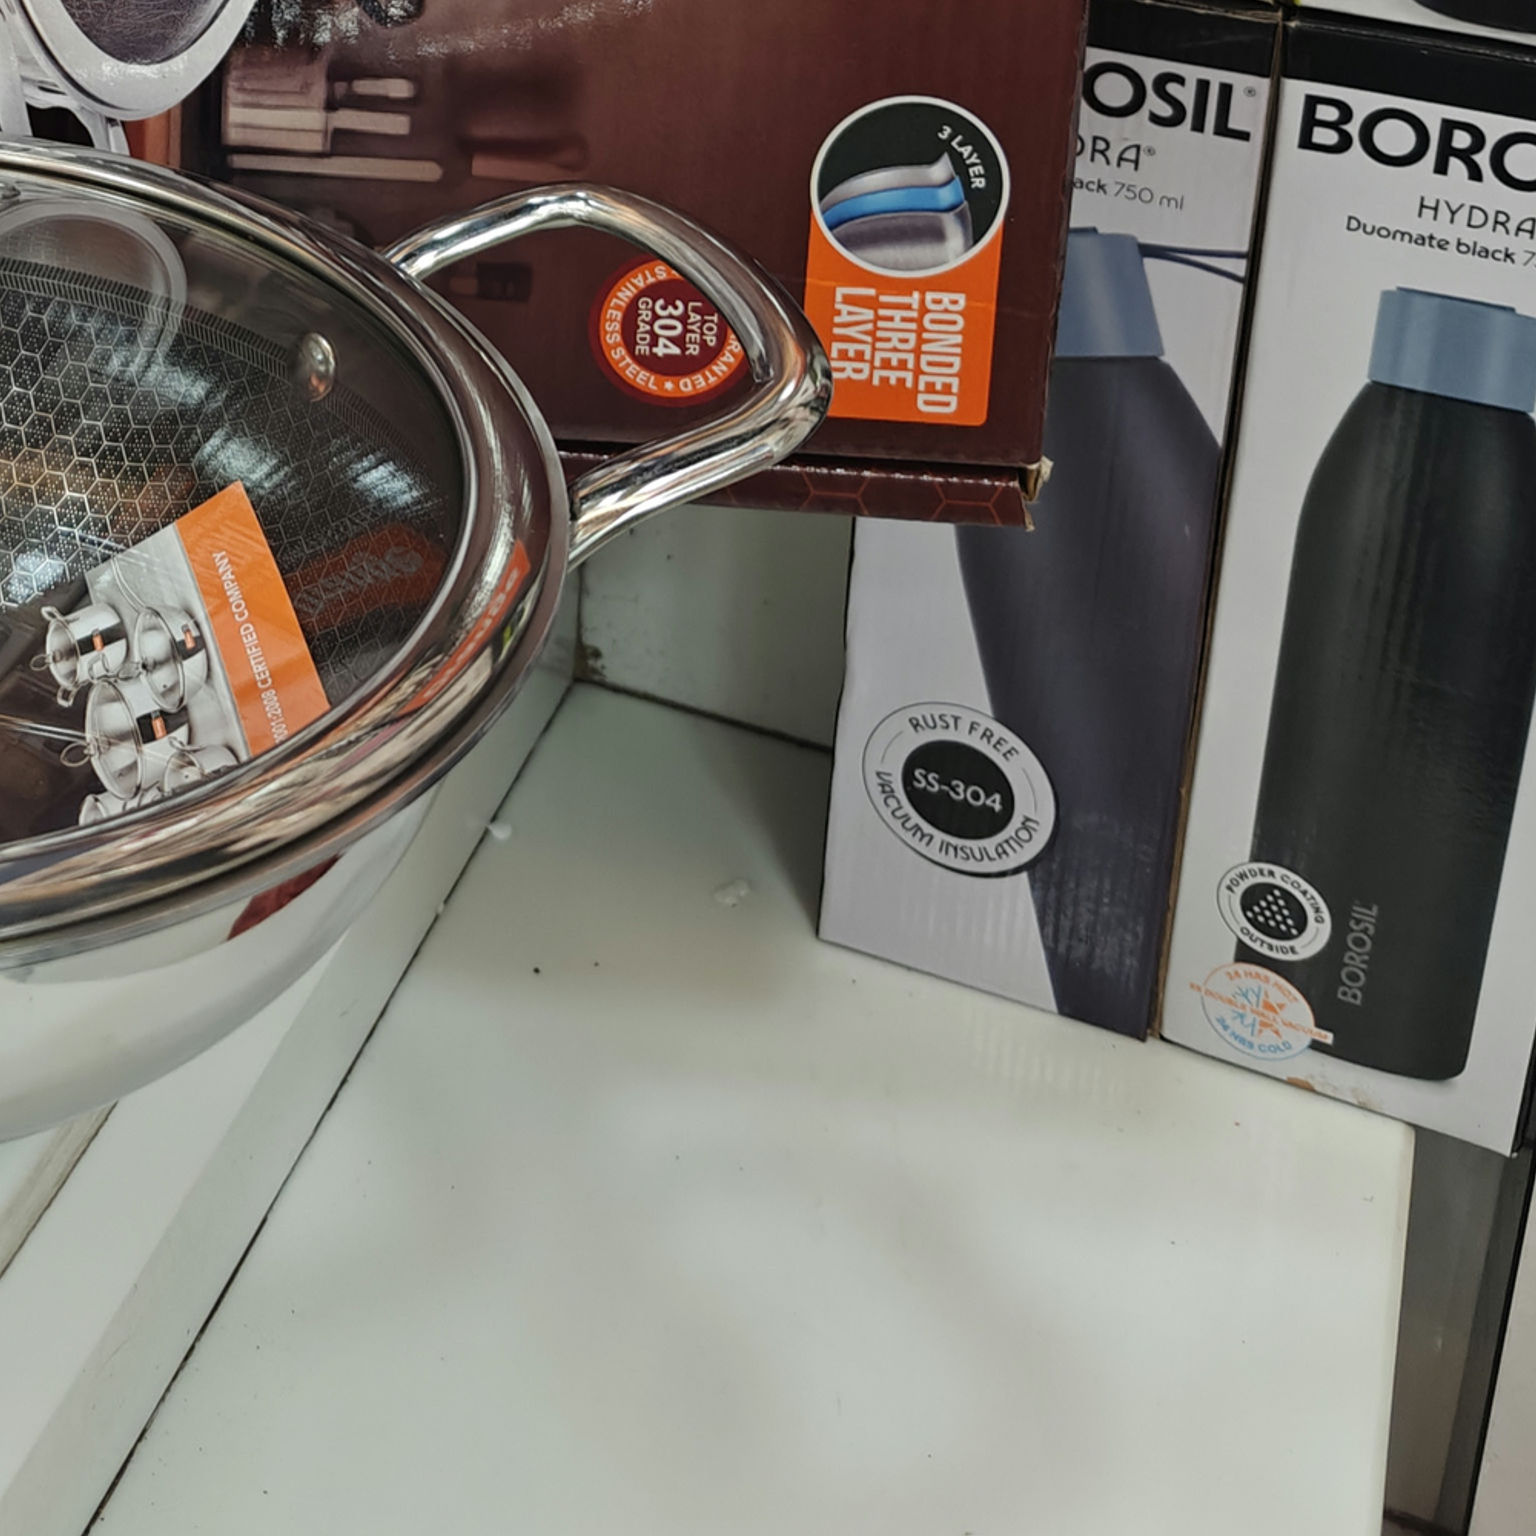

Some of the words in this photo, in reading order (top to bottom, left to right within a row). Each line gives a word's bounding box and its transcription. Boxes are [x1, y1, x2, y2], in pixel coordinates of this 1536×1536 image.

[1082, 60, 1252, 143] OSIL
[937, 124, 953, 140] 3
[950, 134, 986, 189] LAYER
[1072, 177, 1108, 196] ack
[1113, 180, 1155, 205] 750
[1159, 194, 1185, 212] ml
[1417, 194, 1536, 241] HYDRA
[1345, 215, 1451, 252] Duomate
[1455, 237, 1516, 265] black
[1522, 249, 1536, 267] 7
[604, 265, 667, 345] STAINLESS
[634, 296, 653, 357] GRADE
[651, 297, 686, 358] 304
[684, 301, 703, 356] LAYER
[701, 312, 719, 348] TOP
[830, 285, 877, 381] LAYER
[610, 346, 659, 391] STEEL
[678, 332, 742, 393] RANTED
[872, 290, 921, 389] THREE
[916, 290, 966, 414] BONDED
[211, 549, 249, 622] COMPANY
[239, 622, 275, 689] CERTIFIED
[907, 713, 963, 734] RUST
[967, 721, 1020, 762] FREE
[875, 770, 935, 848] VACUUM
[938, 815, 1041, 863] INSULATION
[912, 767, 1003, 814] SS-304
[1226, 867, 1277, 895] POWDER
[1279, 874, 1326, 924] COATING
[1239, 926, 1300, 956] OUTSIDE
[1337, 902, 1379, 1006] BOROSIL
